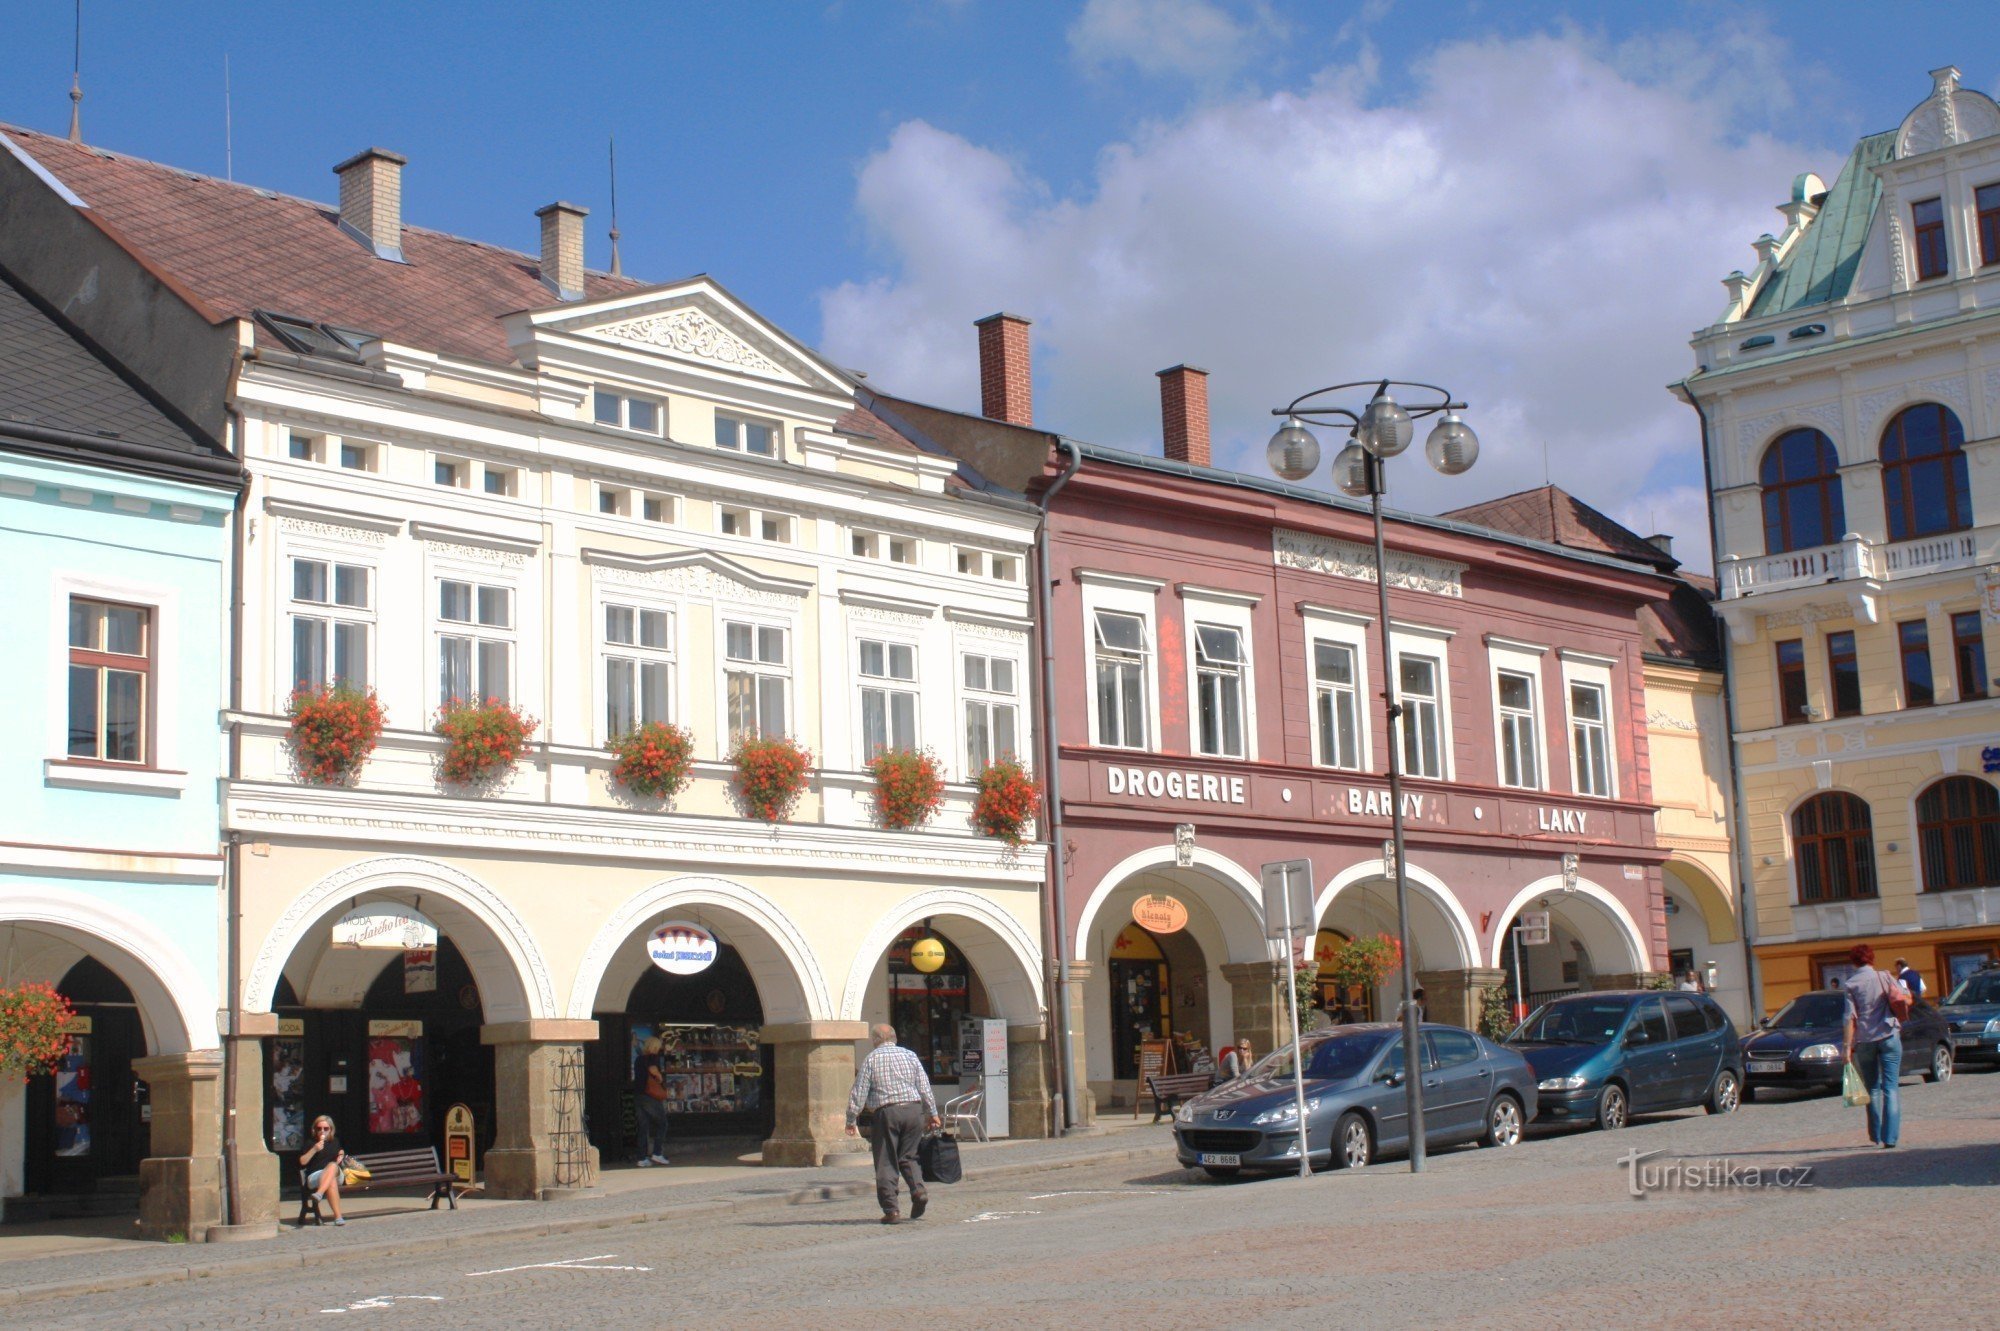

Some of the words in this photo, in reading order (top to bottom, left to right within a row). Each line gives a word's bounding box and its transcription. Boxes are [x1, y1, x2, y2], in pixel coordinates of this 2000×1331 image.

[1108, 766, 1245, 804] DROGERIE
[1348, 788, 1424, 818] BARVY
[1538, 807, 1587, 834] LAKY
[343, 914, 373, 926] MÓDA
